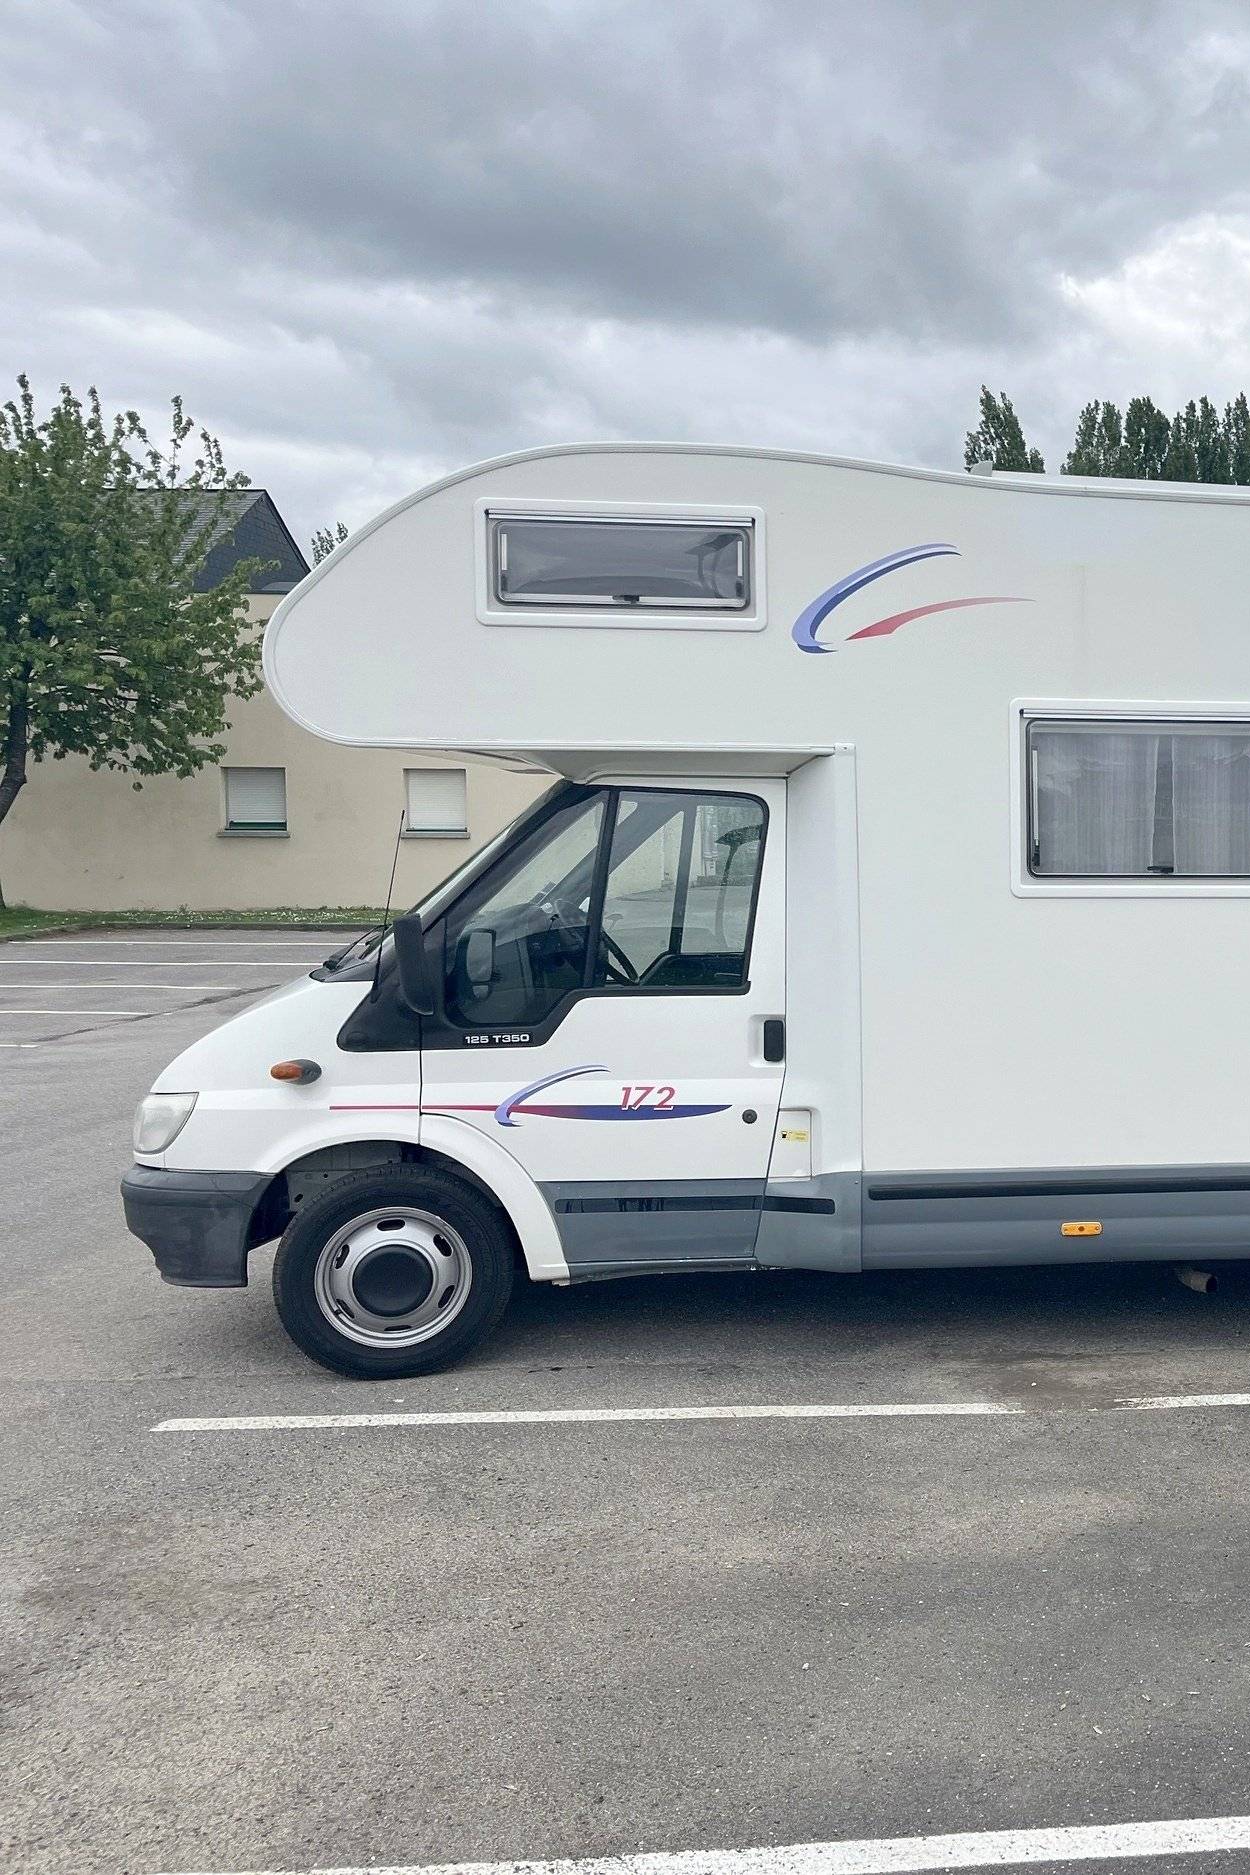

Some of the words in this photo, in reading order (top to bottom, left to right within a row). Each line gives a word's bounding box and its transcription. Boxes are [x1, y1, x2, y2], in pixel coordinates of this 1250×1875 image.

[464, 1035, 490, 1044] 125
[492, 1033, 530, 1043] T350
[620, 1086, 676, 1110] 172
